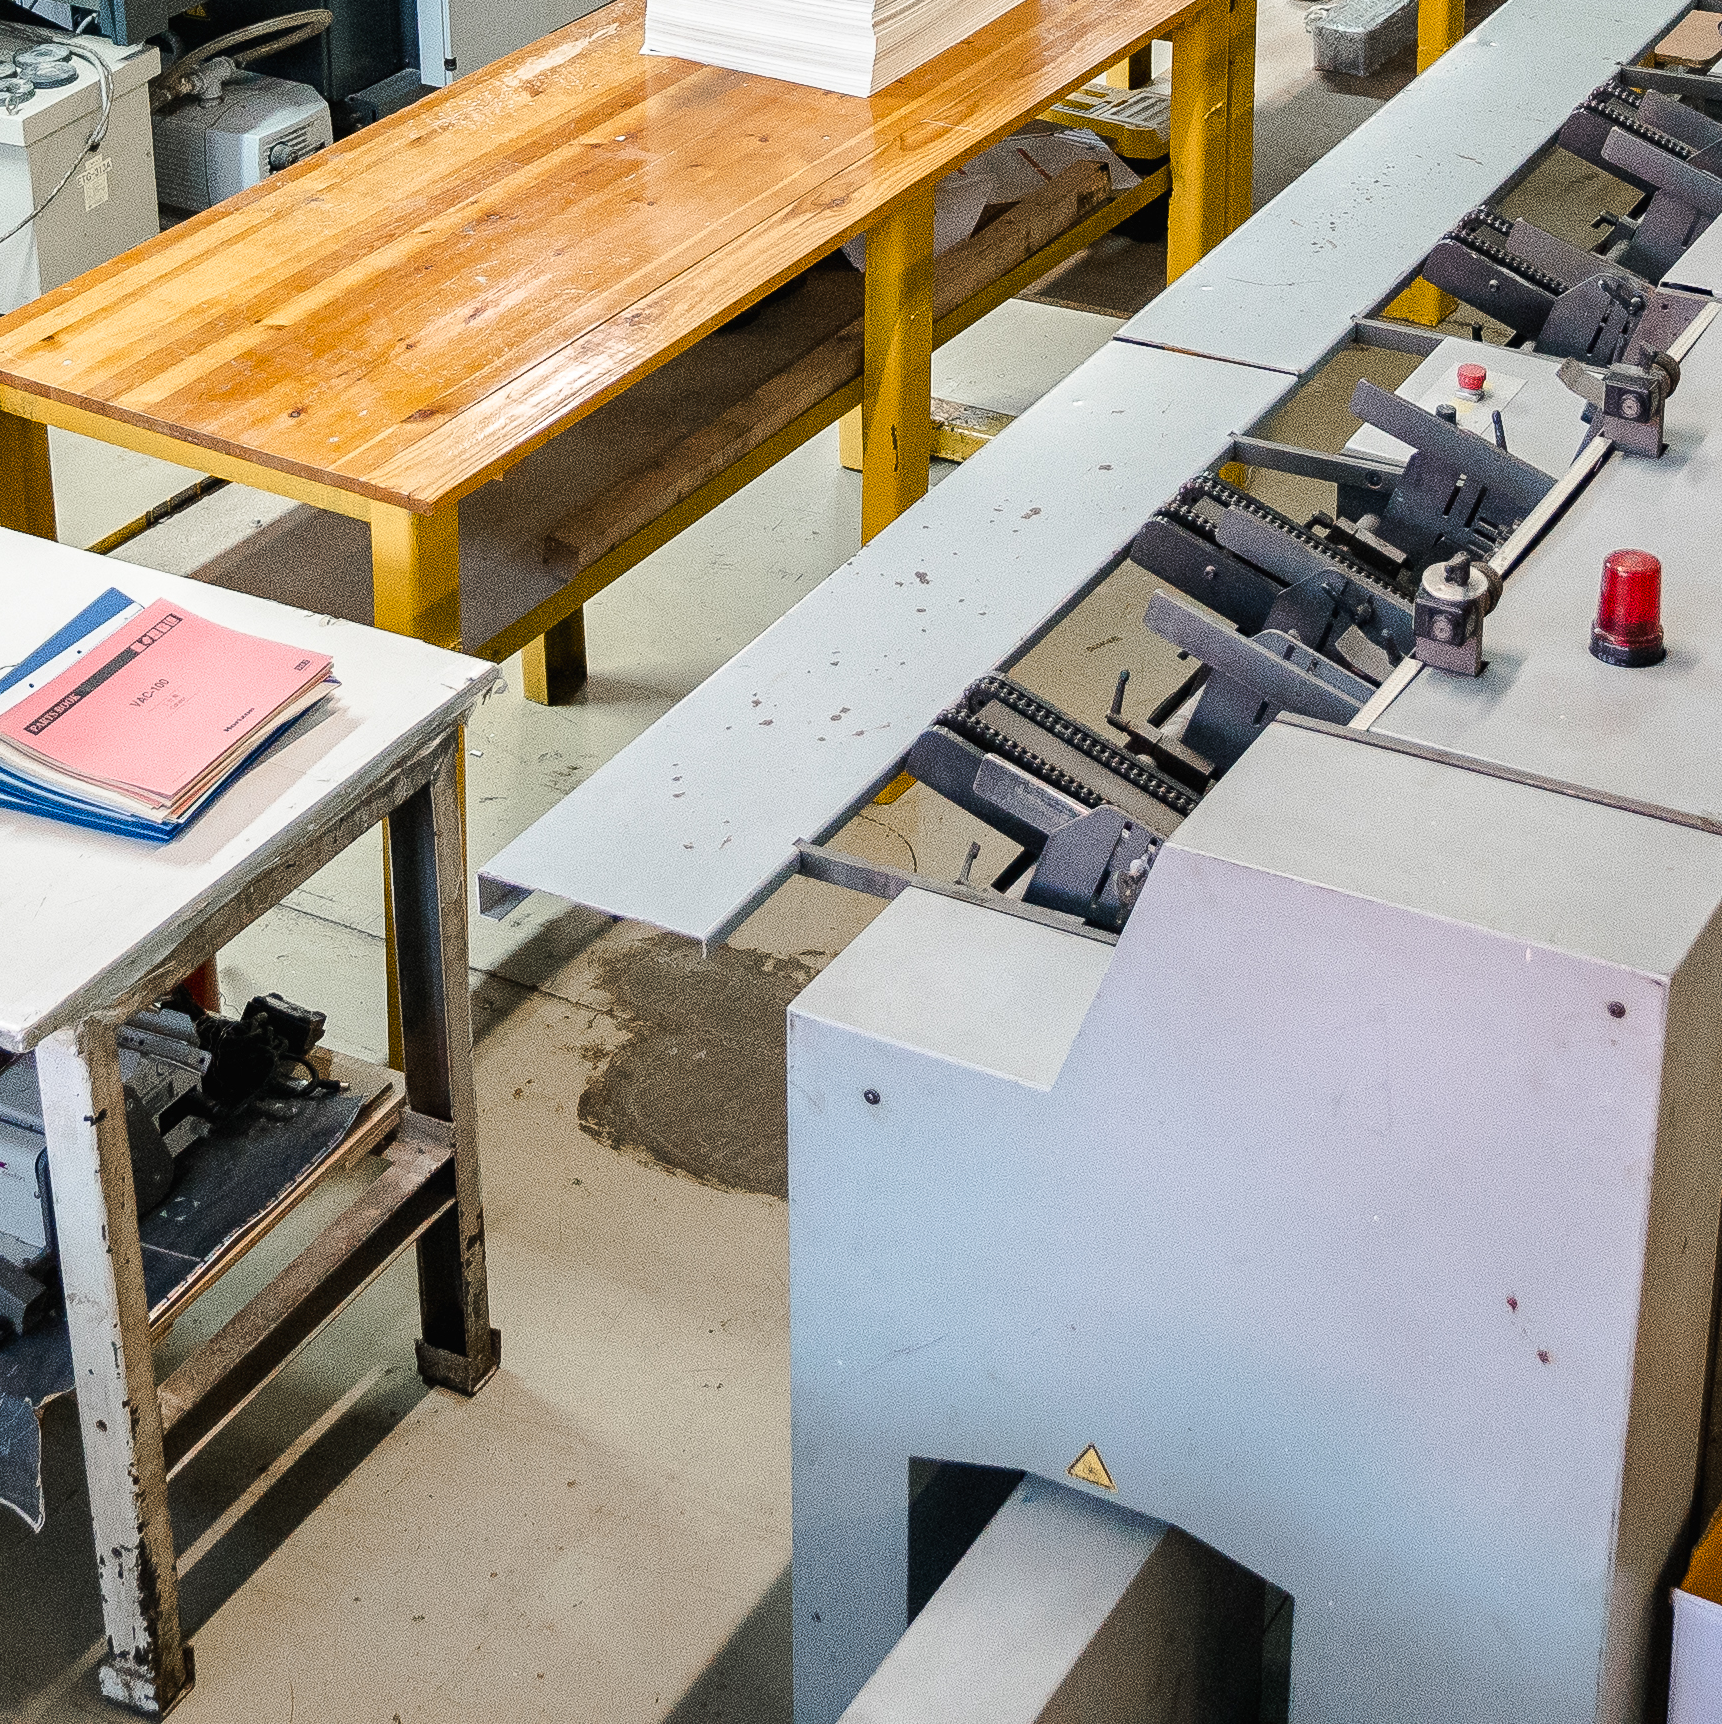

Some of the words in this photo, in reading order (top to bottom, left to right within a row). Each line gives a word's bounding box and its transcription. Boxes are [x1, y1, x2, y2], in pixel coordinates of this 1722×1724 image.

[129, 678, 170, 708] VAC-100
[30, 710, 58, 733] PARTS
[53, 693, 82, 716] BOOK
